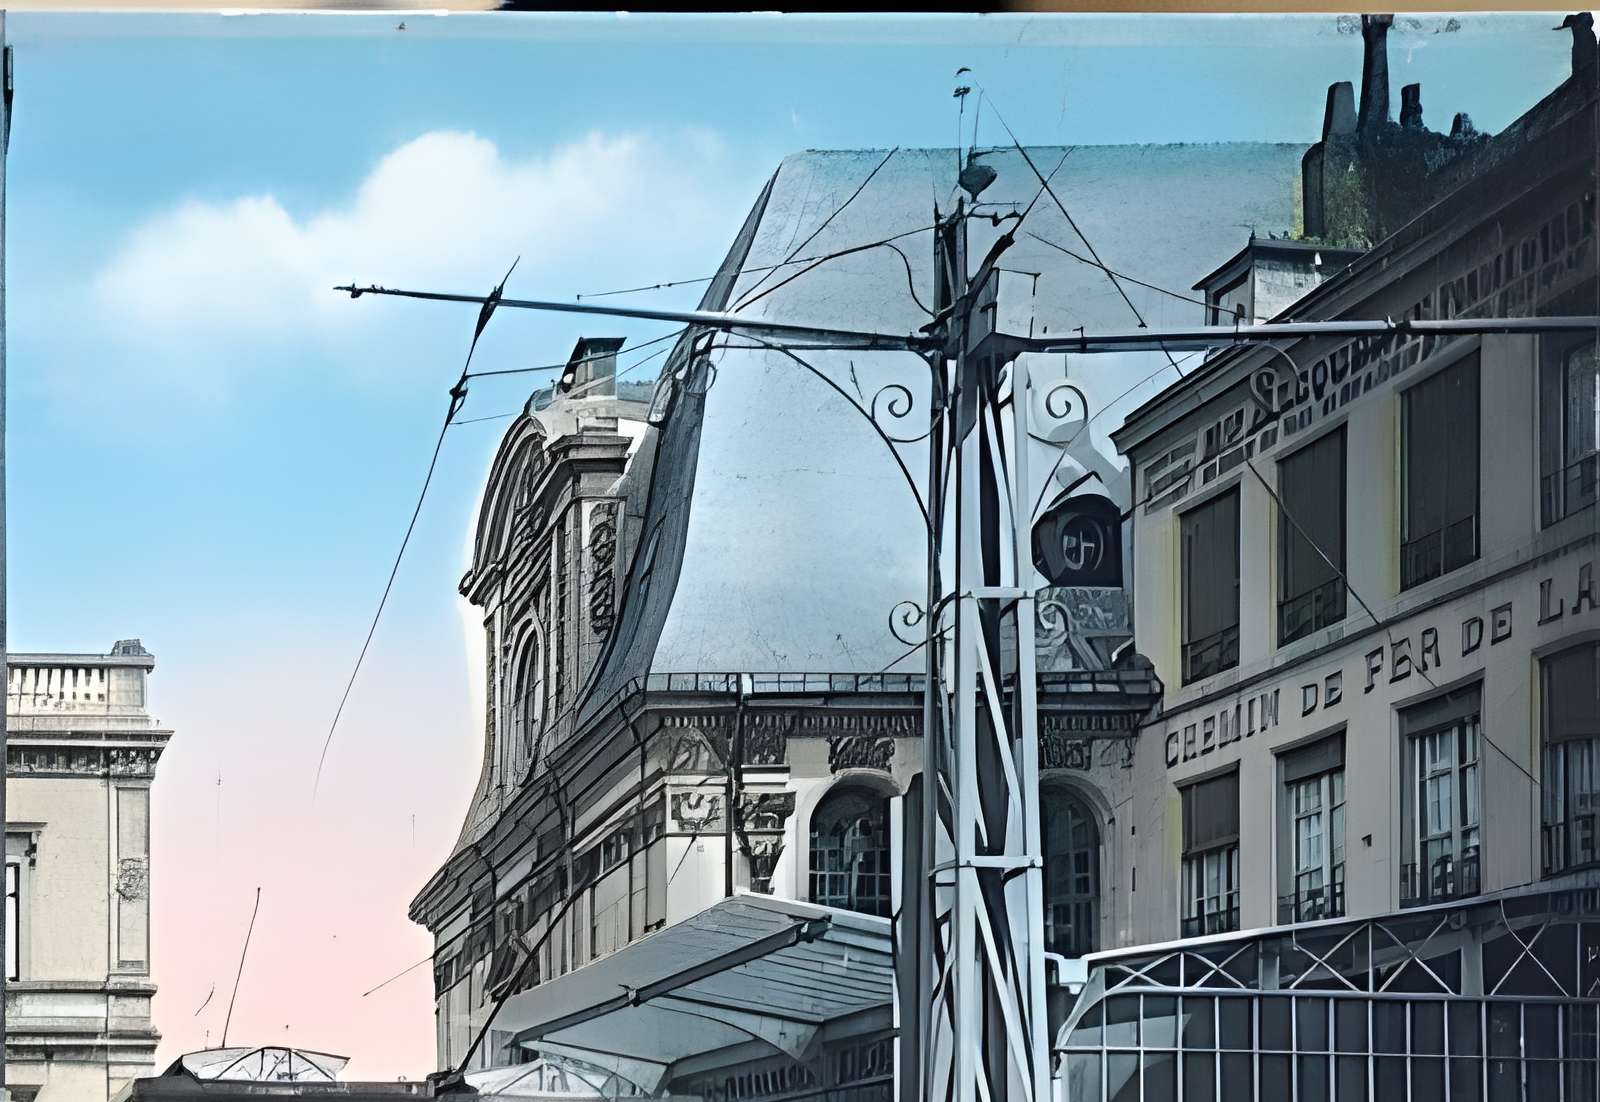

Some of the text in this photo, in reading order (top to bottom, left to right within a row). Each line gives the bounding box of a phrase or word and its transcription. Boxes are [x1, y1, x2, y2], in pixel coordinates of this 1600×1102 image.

[1165, 688, 1281, 769] CHEMIN
[1301, 669, 1343, 718] DE
[1363, 626, 1441, 694] FER
[1461, 601, 1513, 657] DE
